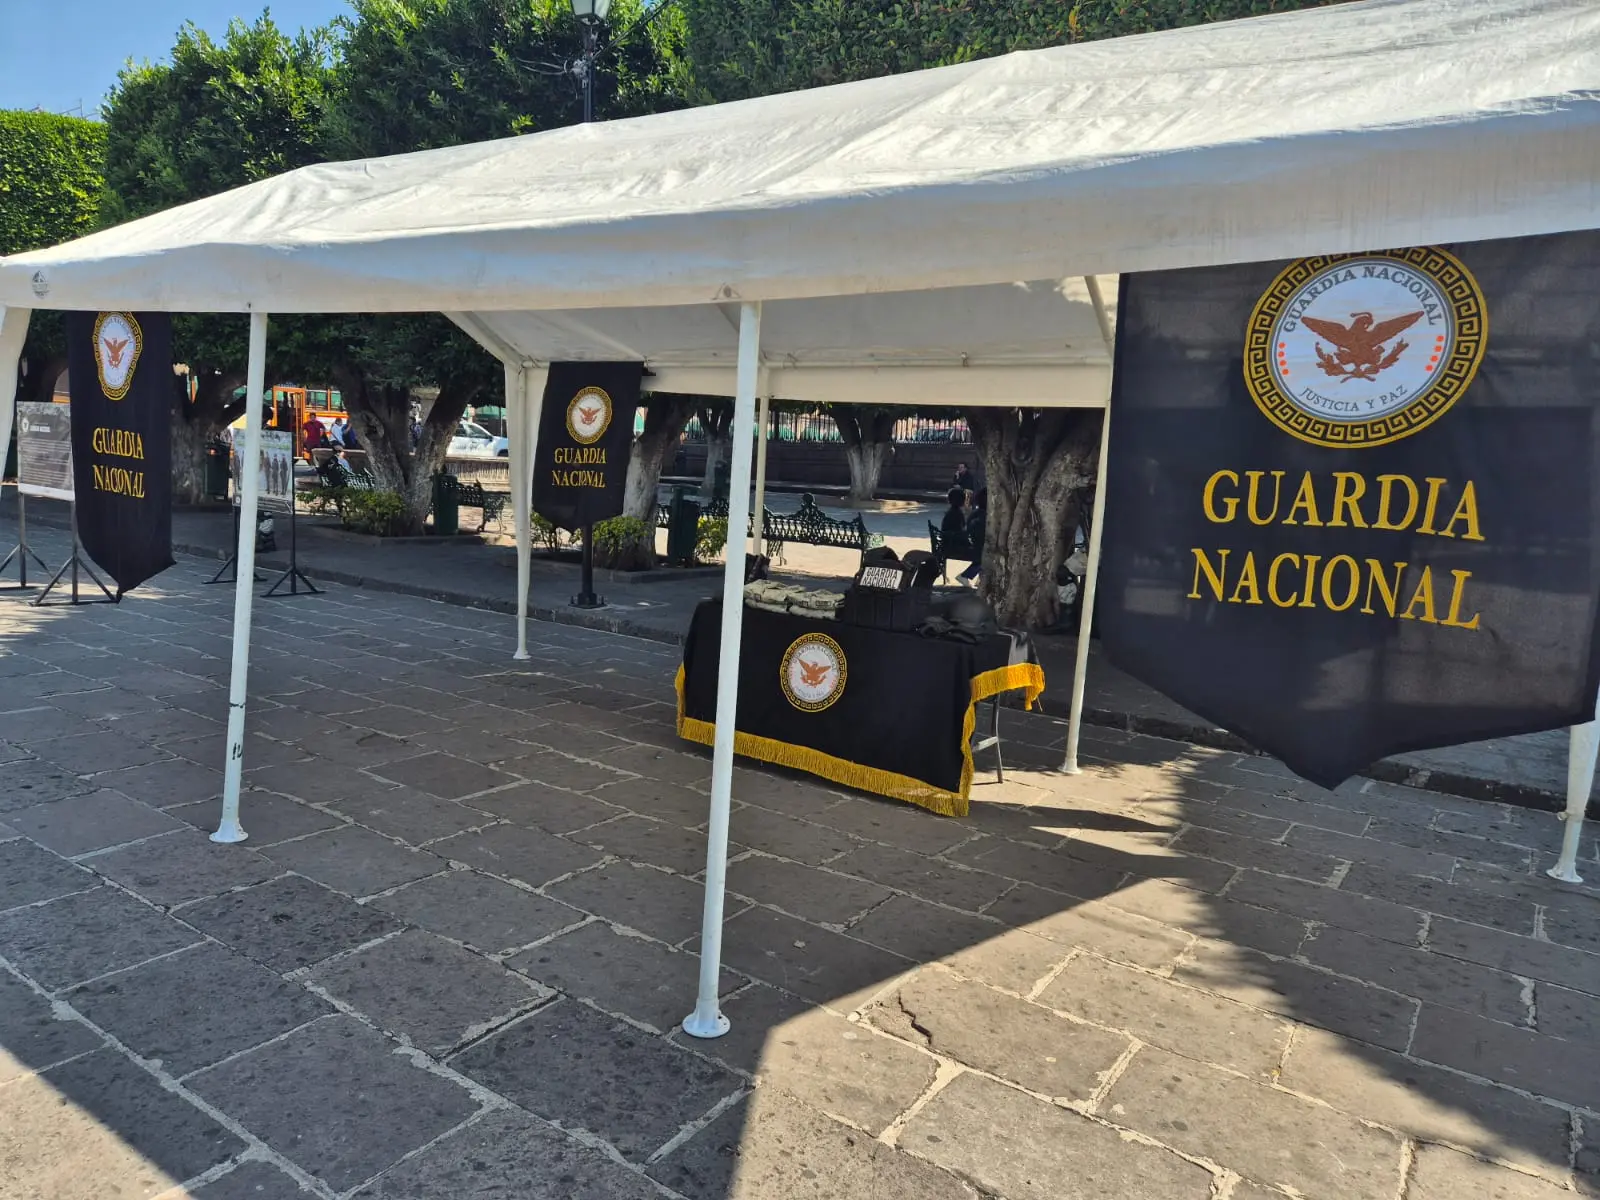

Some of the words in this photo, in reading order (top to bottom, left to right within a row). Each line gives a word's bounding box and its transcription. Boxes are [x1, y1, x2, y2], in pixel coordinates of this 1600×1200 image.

[1283, 269, 1357, 333] GUARDIA
[1362, 266, 1443, 326] NACIONAL
[1299, 386, 1360, 412] JUSTICIA
[1365, 399, 1376, 410] Y
[1379, 384, 1408, 405] PAZ
[92, 426, 145, 460] GUARDIA
[554, 447, 606, 464] GUARDIA
[92, 464, 145, 498] NACIONAL
[551, 469, 606, 488] NACIONAL
[1202, 469, 1486, 542] GUARDIA
[862, 576, 897, 589] NACIONAL
[866, 567, 898, 579] GUARDIA
[1187, 547, 1480, 630] NACIONAL
